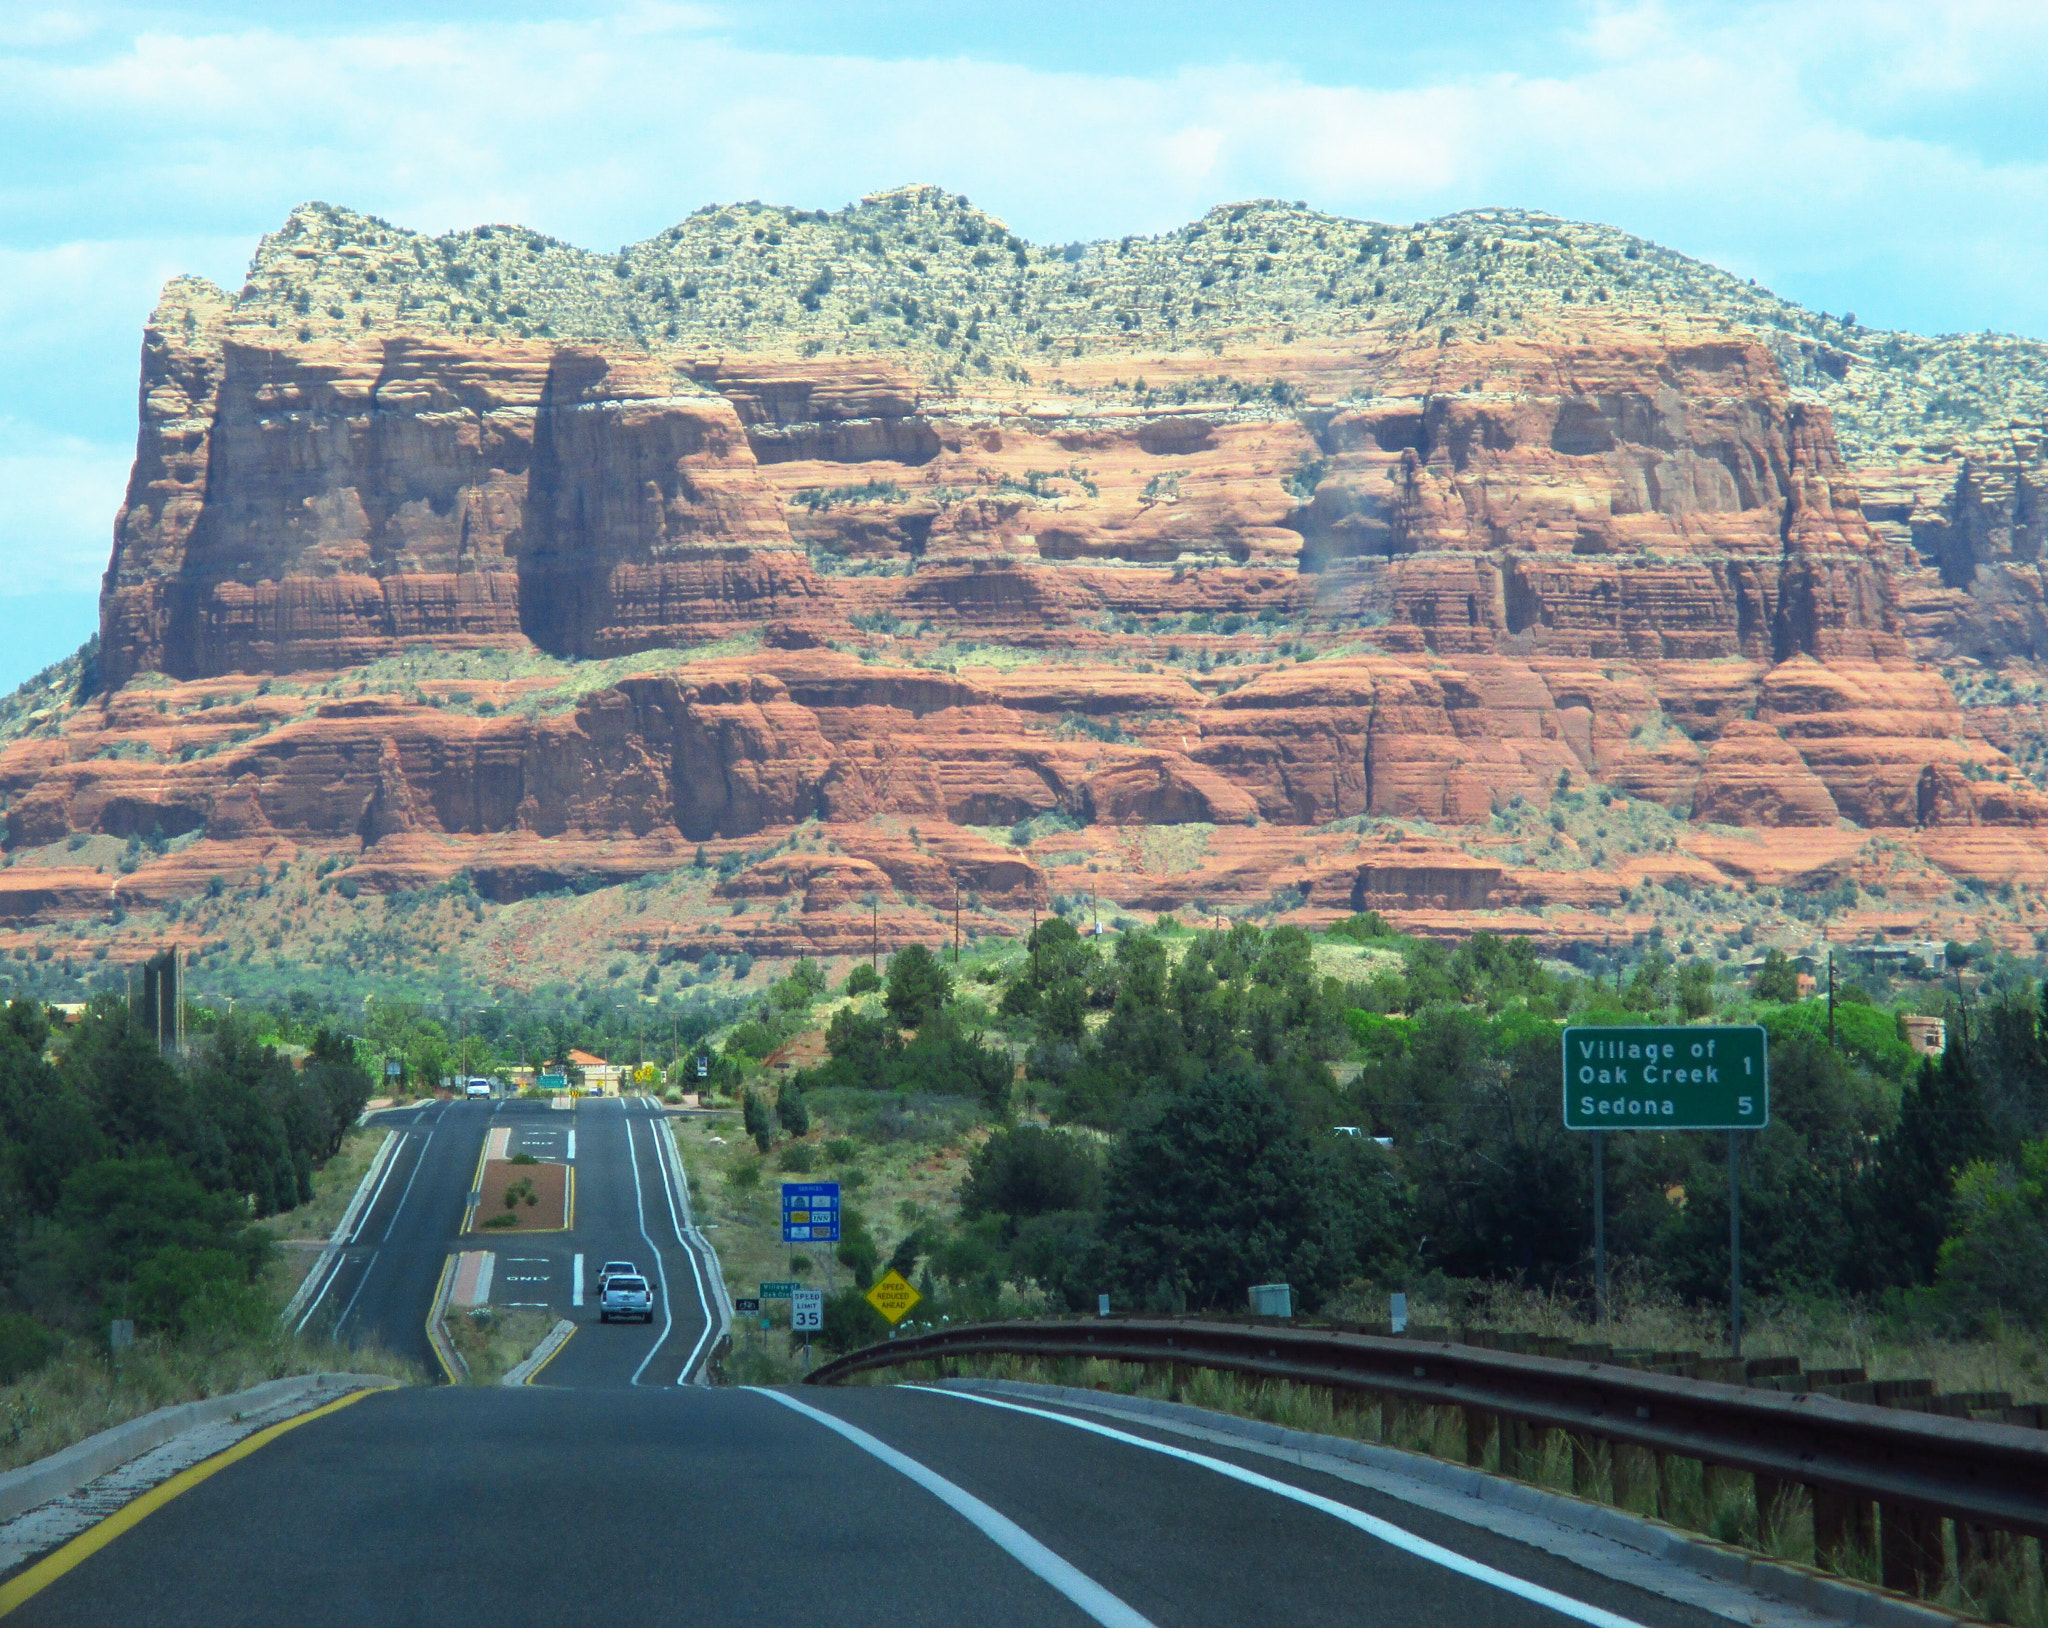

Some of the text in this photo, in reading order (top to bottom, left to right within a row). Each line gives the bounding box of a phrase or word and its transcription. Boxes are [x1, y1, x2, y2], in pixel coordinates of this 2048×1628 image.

[1579, 1039, 1716, 1064] Village of
[1579, 1065, 1719, 1084] Oak Creek
[1743, 1056, 1752, 1075] 1
[1580, 1096, 1753, 1115] Sedona 5
[796, 1312, 819, 1326] 35
